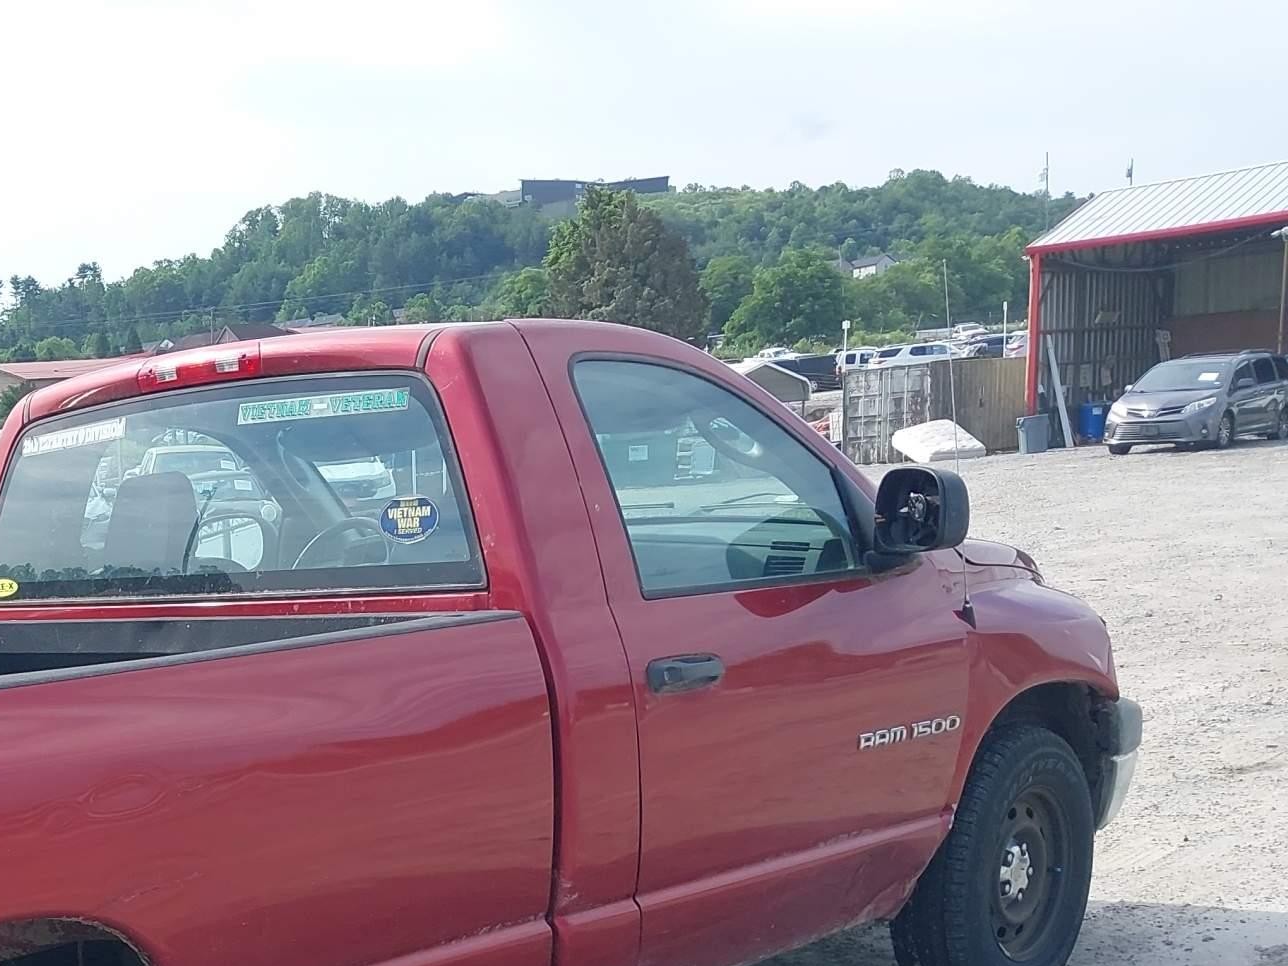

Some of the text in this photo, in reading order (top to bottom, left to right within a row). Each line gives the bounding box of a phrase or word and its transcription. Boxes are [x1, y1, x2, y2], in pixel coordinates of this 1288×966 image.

[241, 391, 409, 421] VIETNAM VETERAN
[387, 505, 431, 520] VIETNAM
[397, 517, 420, 529] WAR
[859, 715, 961, 750] RAM 1500
